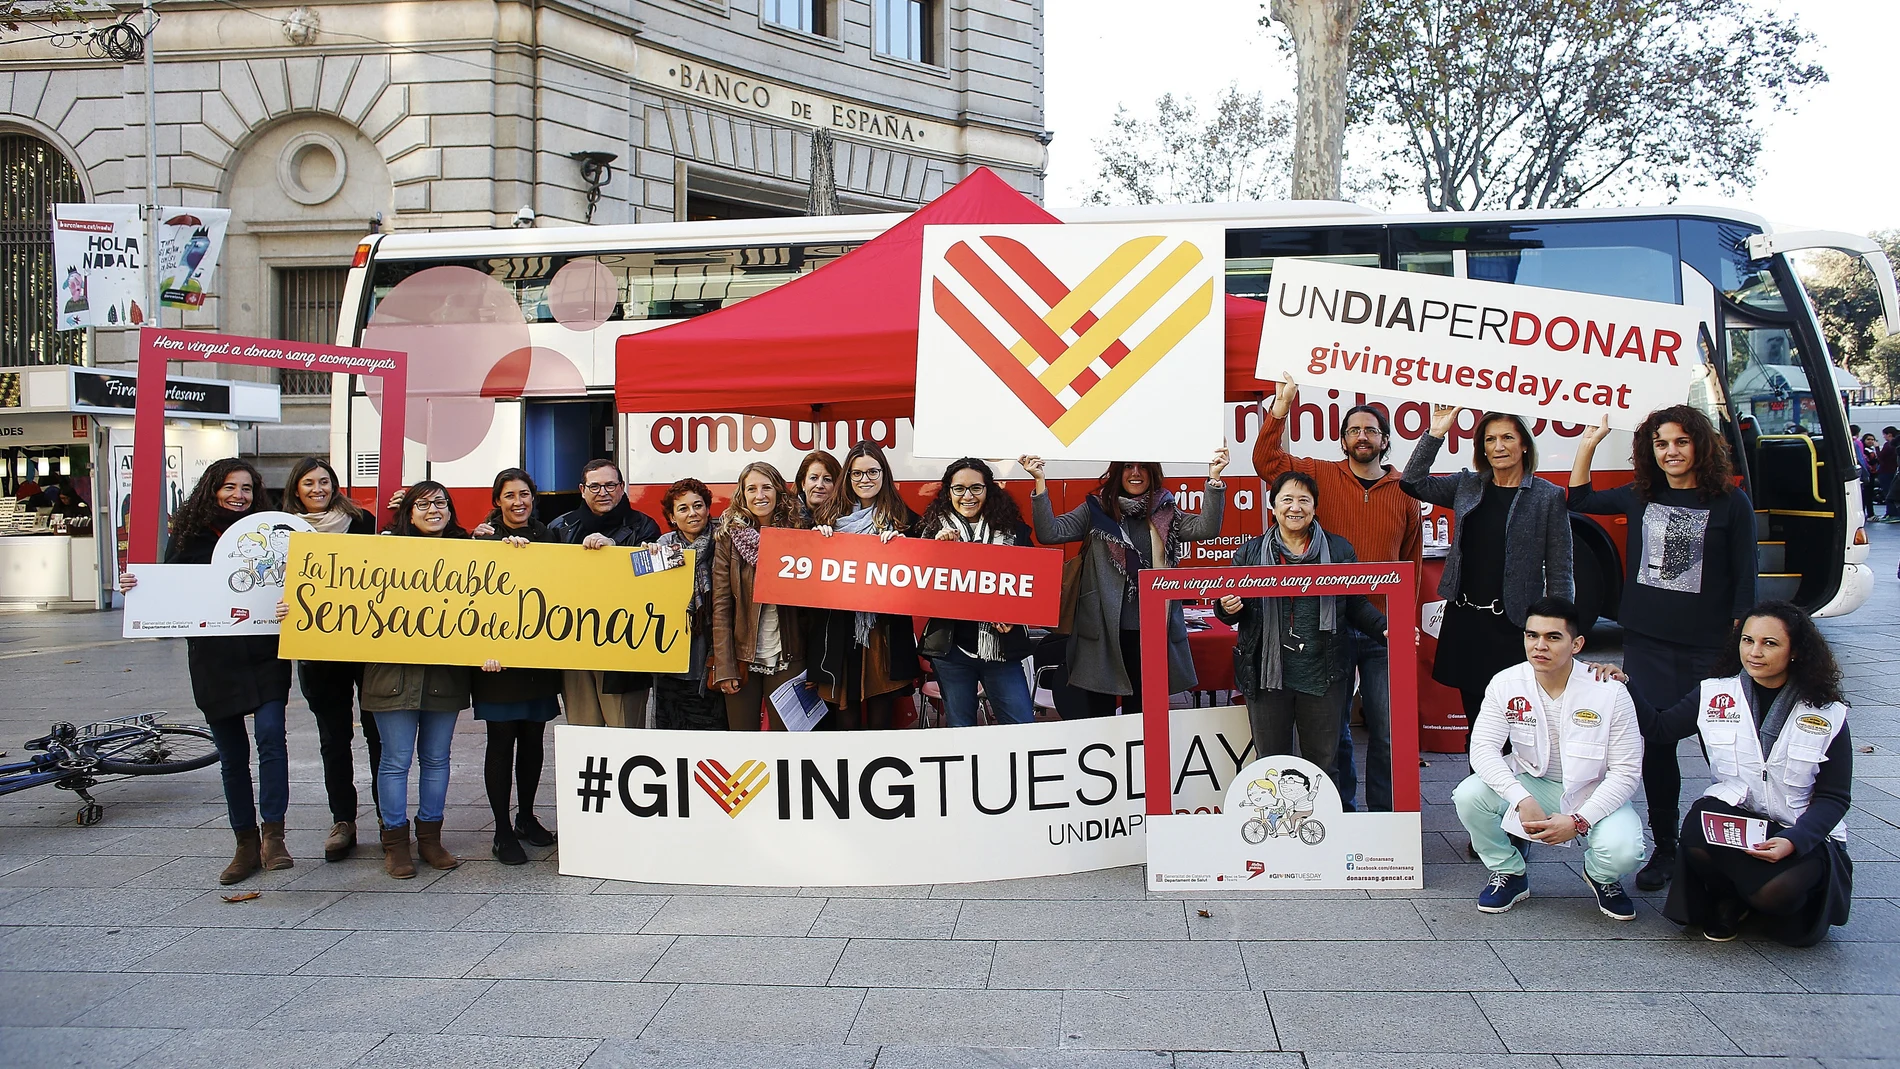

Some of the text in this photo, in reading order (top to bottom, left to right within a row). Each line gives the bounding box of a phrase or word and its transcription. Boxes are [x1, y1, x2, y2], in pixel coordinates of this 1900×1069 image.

[680, 64, 915, 142] BANCO DE ESPAÑA
[83, 253, 139, 269] NADAL
[89, 236, 139, 254] HOLA
[1278, 282, 1684, 366] UNDIAPERDONAR
[153, 335, 396, 373] Hem vingut a donar sang acompanyats
[106, 380, 206, 401] Fira rtesans
[1307, 342, 1632, 409] givingtuesday.cat
[650, 415, 776, 454] amb
[1234, 490, 1253, 511] a
[1196, 533, 1255, 545] Generalit
[1196, 547, 1238, 561] Depar
[298, 552, 516, 602] La Inigualable
[778, 555, 1034, 598] 29 DE NOVEMBRE
[1151, 570, 1402, 595] Hem vingut a donar sang acompanyats
[297, 583, 679, 653] Sensació de Donar
